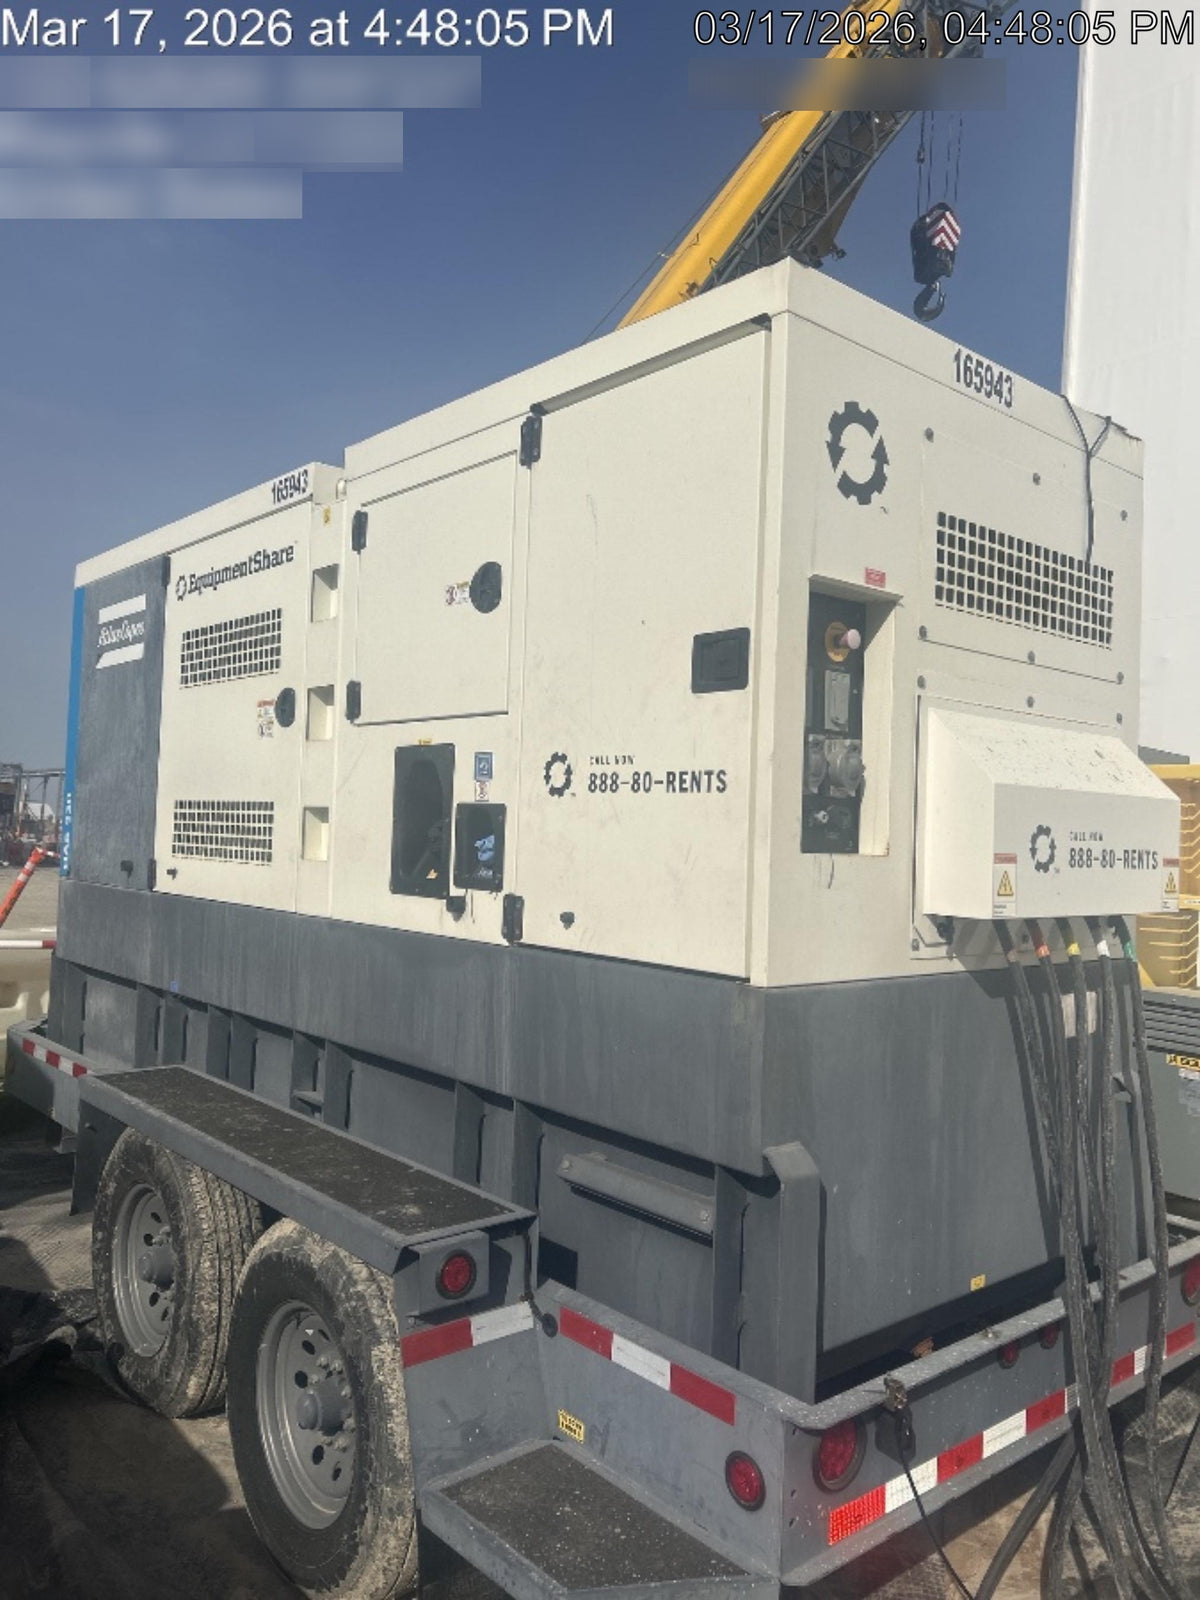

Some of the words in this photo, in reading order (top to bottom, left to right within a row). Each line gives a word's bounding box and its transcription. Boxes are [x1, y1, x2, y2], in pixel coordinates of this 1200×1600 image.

[954, 348, 1013, 409] 165943
[271, 469, 308, 505] 165943
[188, 545, 294, 595] EquipmentShare
[587, 769, 728, 794] 888-80-RENTS
[1068, 847, 1159, 870] 888-80-RENTS
